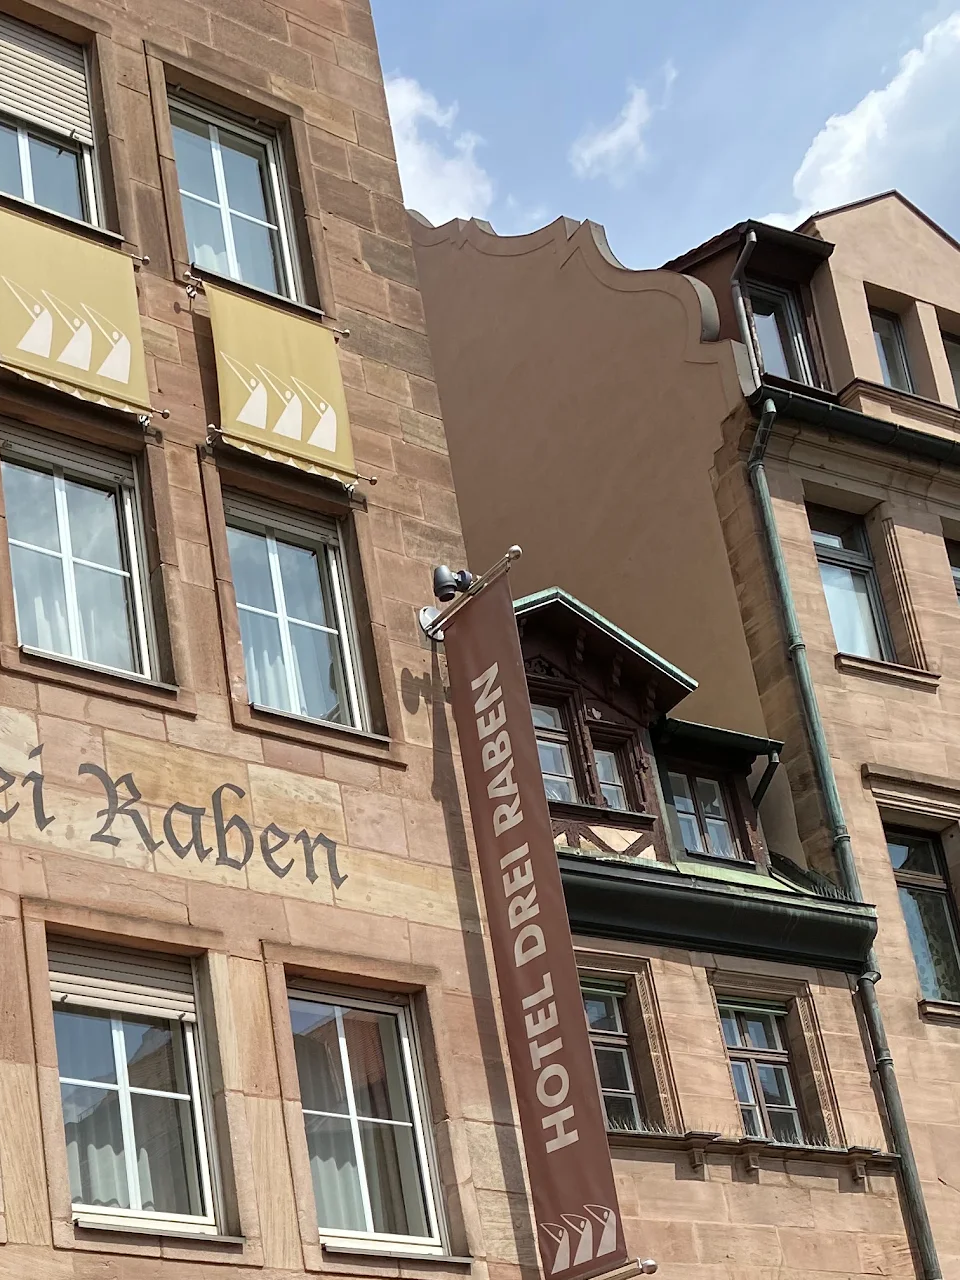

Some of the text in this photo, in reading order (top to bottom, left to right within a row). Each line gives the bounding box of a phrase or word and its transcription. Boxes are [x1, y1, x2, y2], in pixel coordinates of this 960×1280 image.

[77, 762, 350, 889] Raben
[470, 661, 580, 1155] HOTEL DREI RABEN
